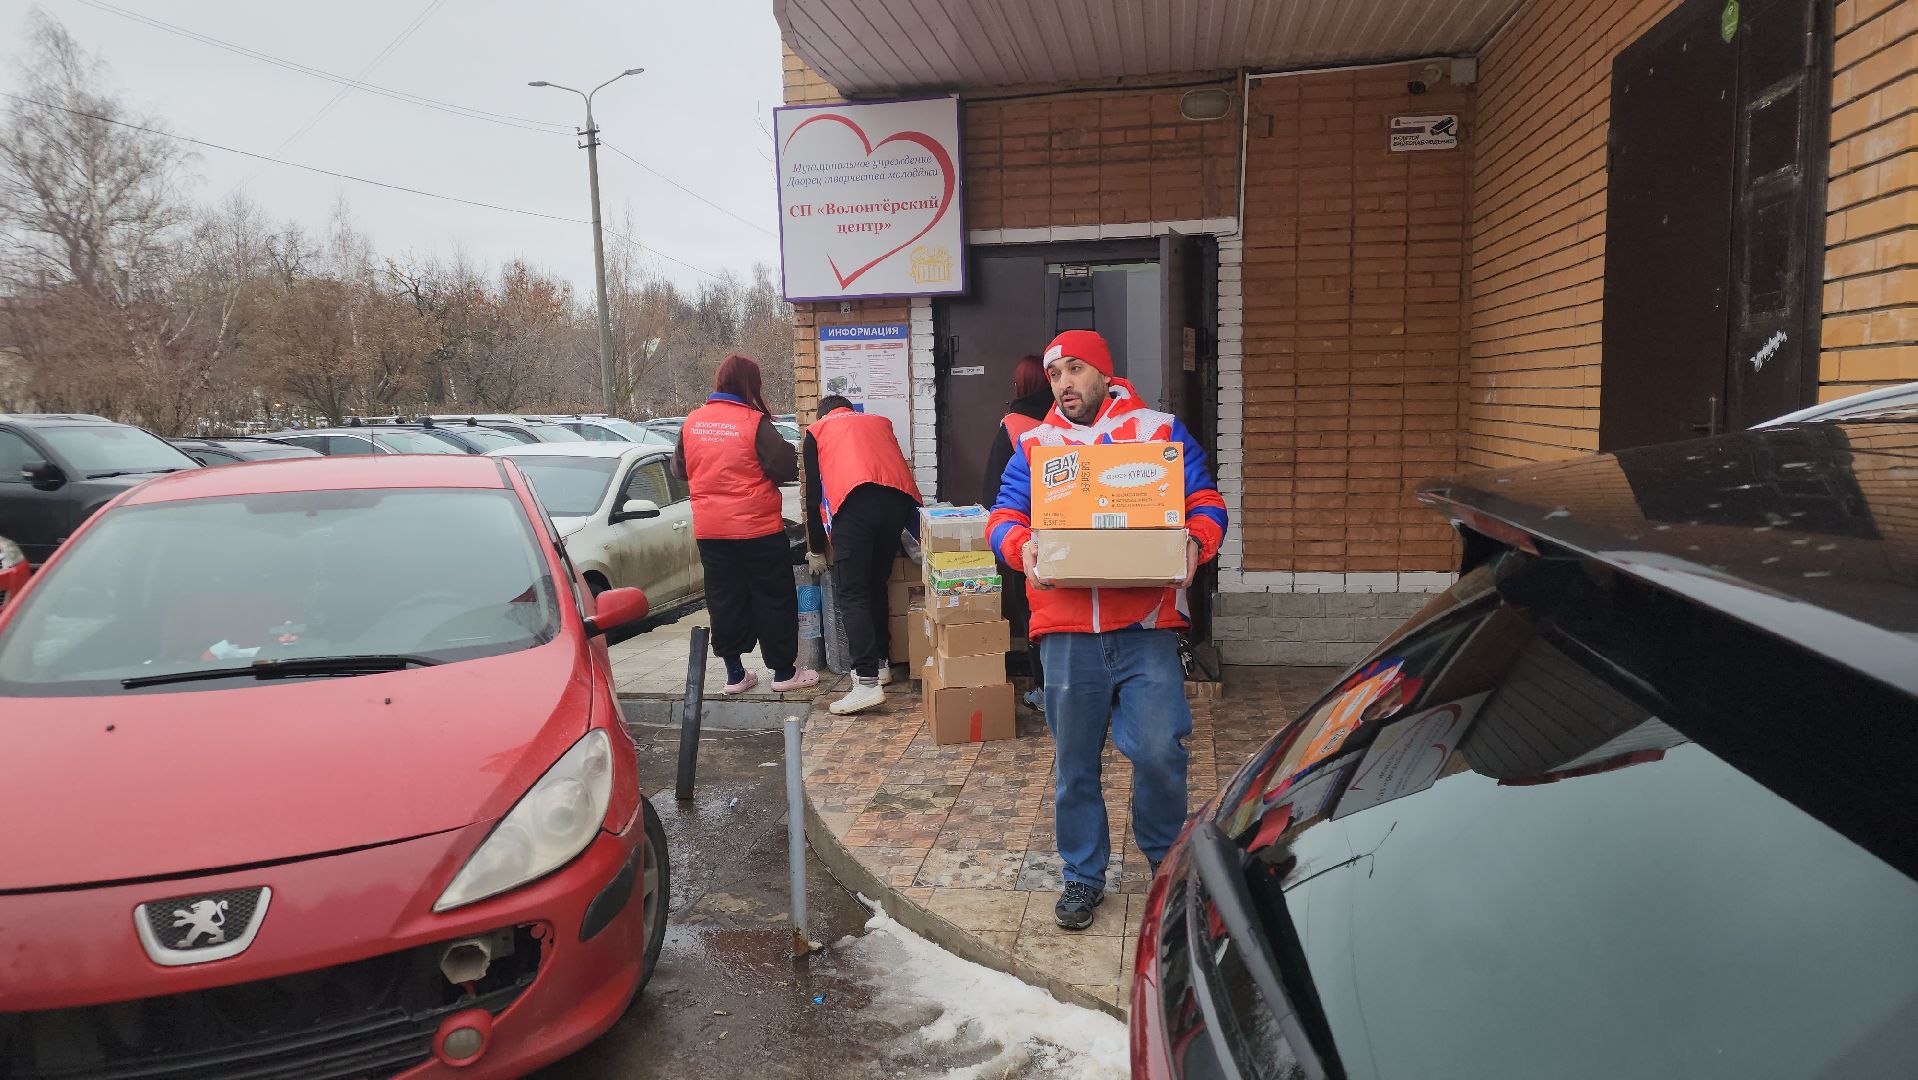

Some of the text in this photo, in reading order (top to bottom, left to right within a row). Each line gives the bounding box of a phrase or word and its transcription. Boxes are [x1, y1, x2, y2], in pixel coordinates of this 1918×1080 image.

[792, 155, 932, 174] Муниципальное учреждение
[786, 176, 823, 188] Дворец
[824, 172, 886, 185] творчества
[789, 196, 939, 217] СП «Волонтёрский
[837, 221, 892, 235] центр»
[828, 326, 899, 337] ИНФОРМАЦИЯ
[1128, 468, 1157, 480] КУРИЦЫ
